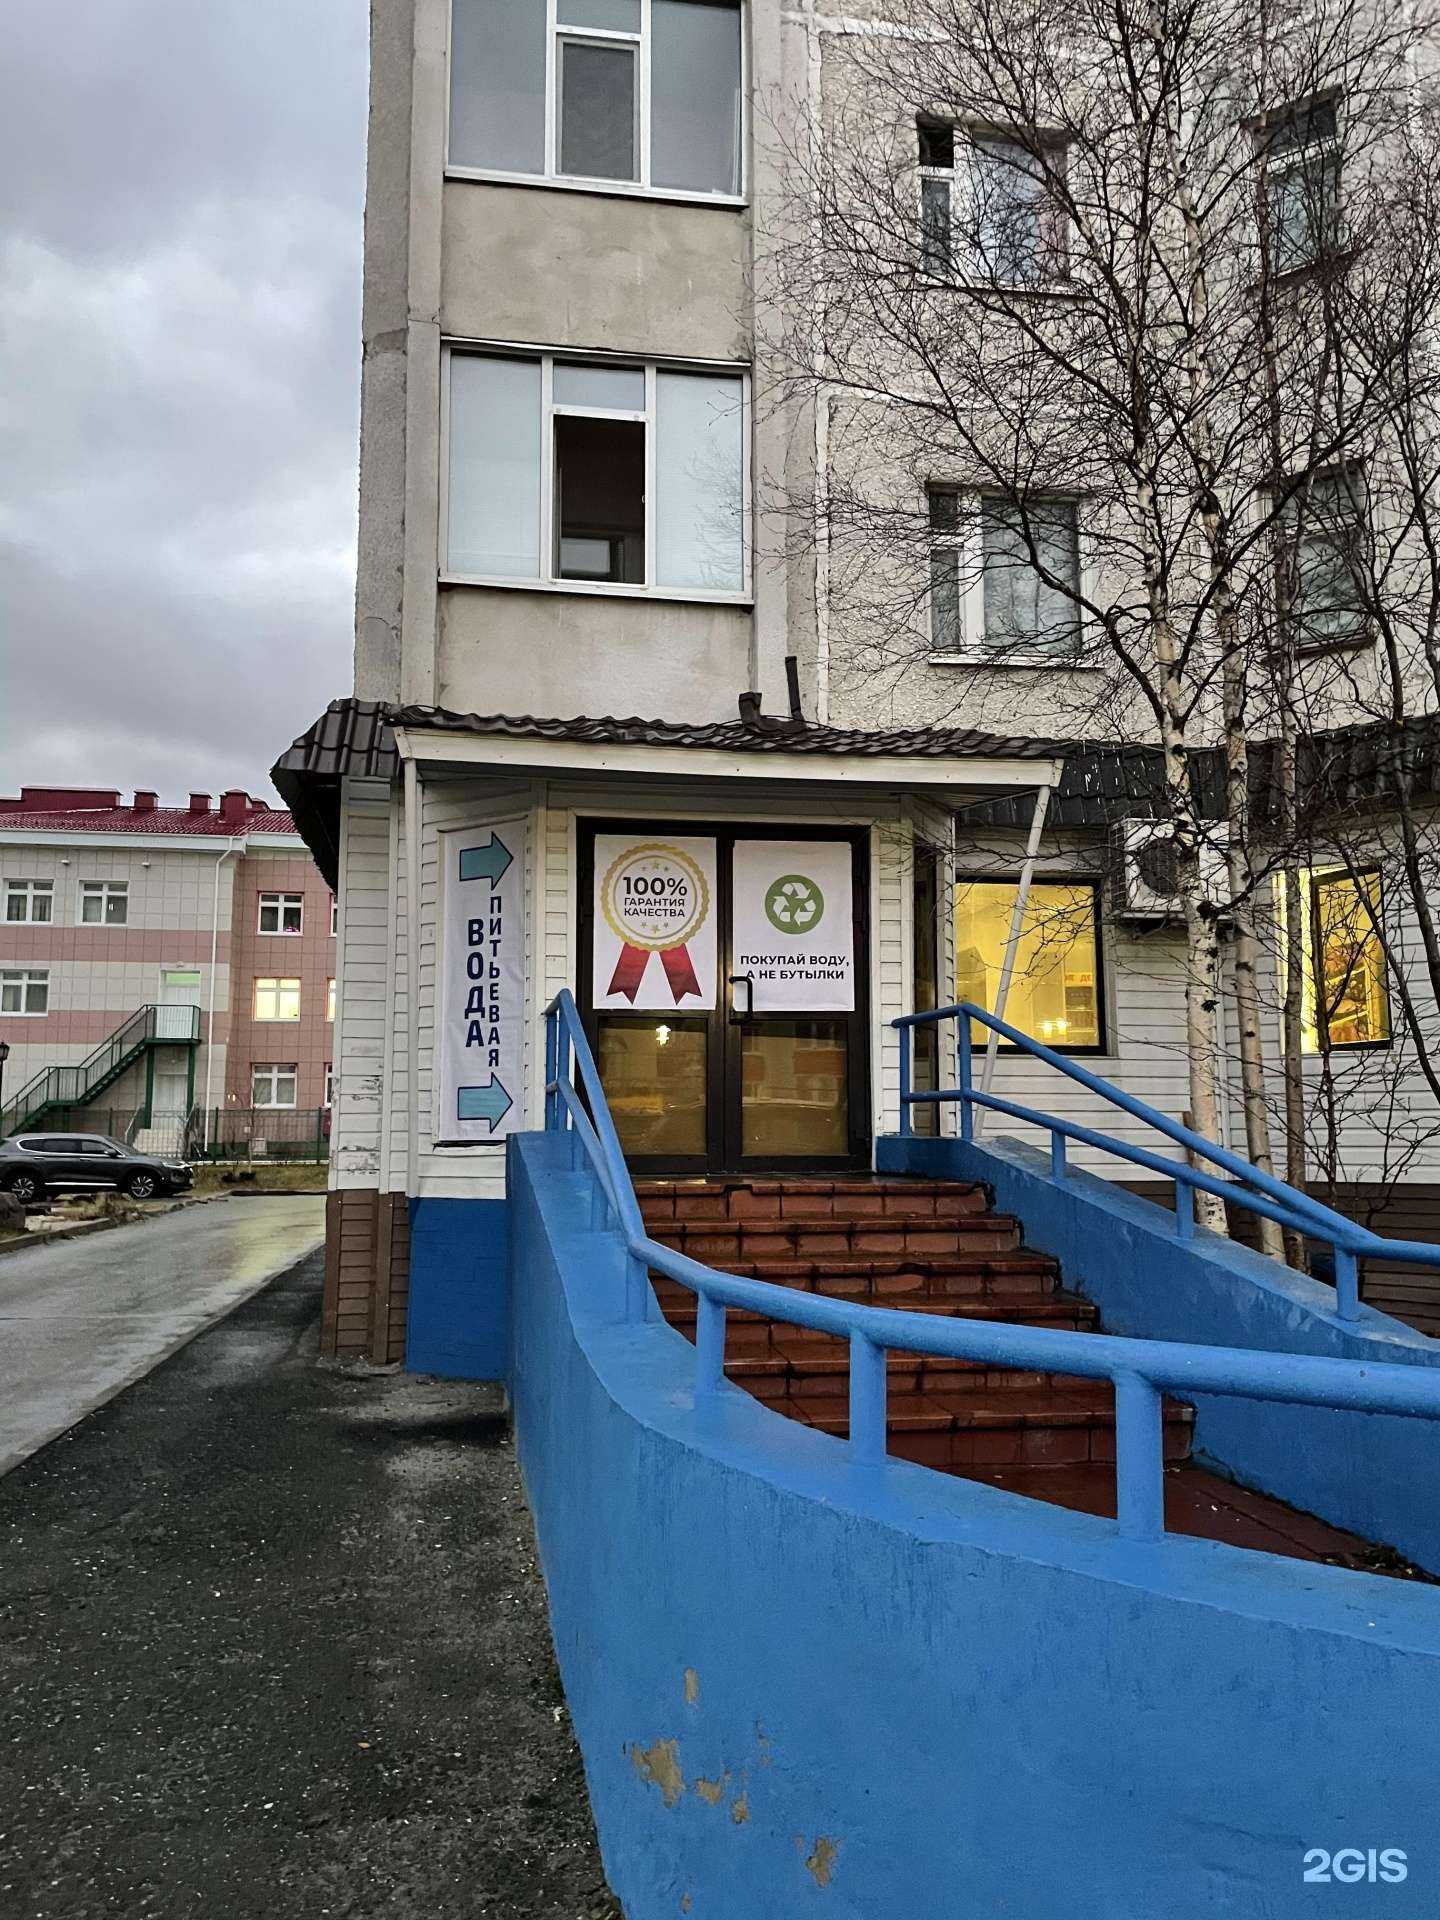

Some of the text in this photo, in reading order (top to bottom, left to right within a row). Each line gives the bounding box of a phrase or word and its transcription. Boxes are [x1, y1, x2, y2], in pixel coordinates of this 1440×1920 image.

[623, 876, 688, 896] 100%
[624, 897, 685, 907] ГАРАНТИЯ
[624, 908, 685, 917] КАЧЕСТВА
[740, 953, 850, 967] ПОКУПАЙ ВОДУ,
[487, 895, 502, 1068] ПИТЬЕВАЯ
[746, 970, 844, 979] А НЕ БУТЫЛКИ
[464, 918, 486, 1048] ВОДА
